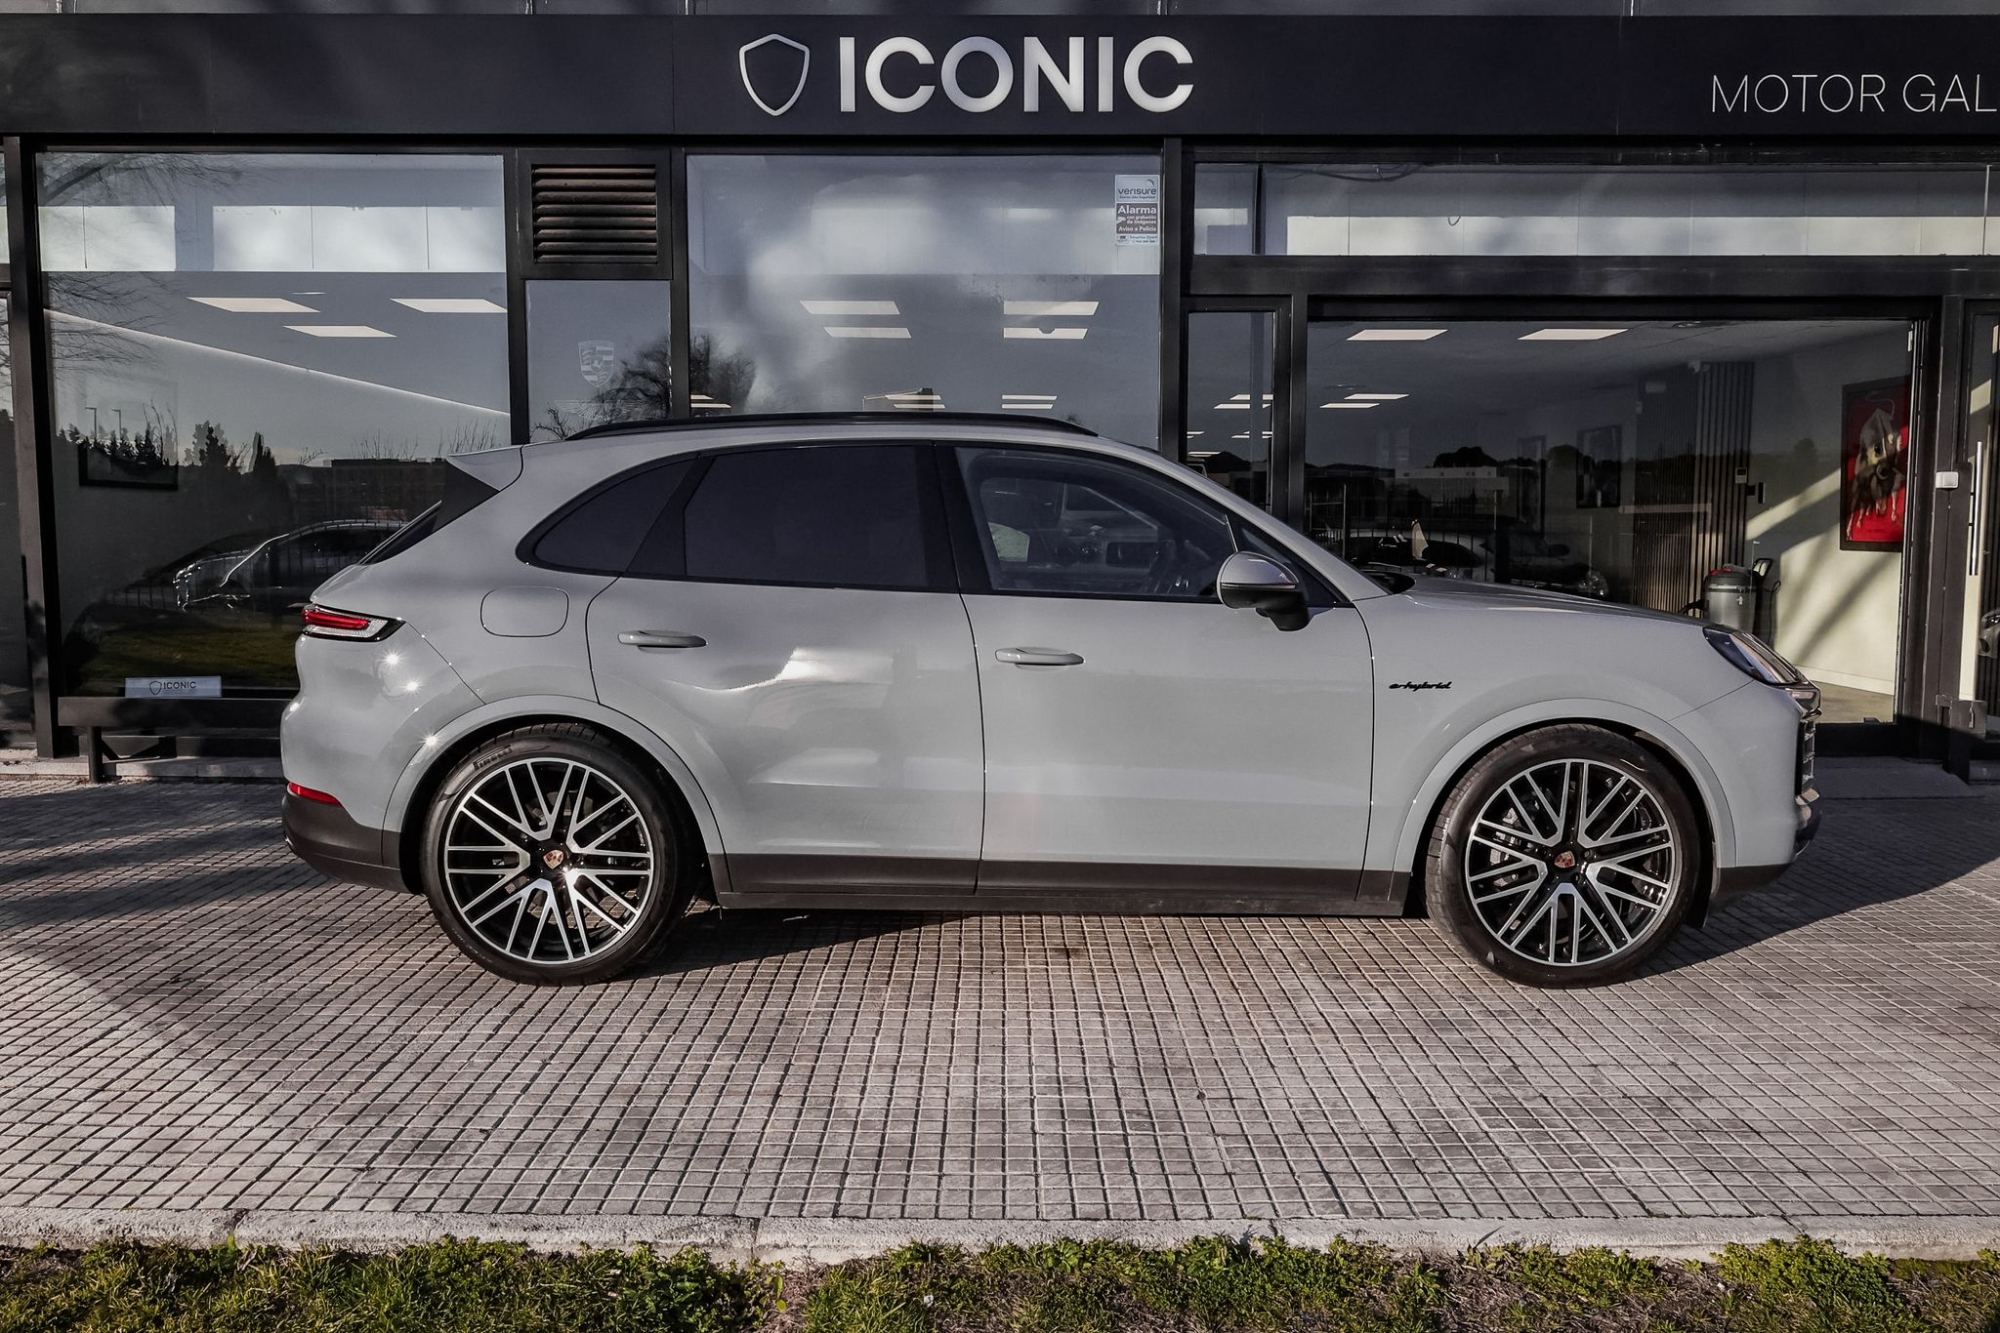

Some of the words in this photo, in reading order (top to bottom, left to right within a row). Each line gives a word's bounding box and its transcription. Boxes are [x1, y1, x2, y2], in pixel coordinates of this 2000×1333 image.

[839, 36, 1194, 113] ICONIC
[1711, 74, 1886, 113] MOTOR
[1902, 74, 1998, 112] GAL
[1117, 205, 1157, 214] Alarma
[163, 681, 197, 690] ICONIC
